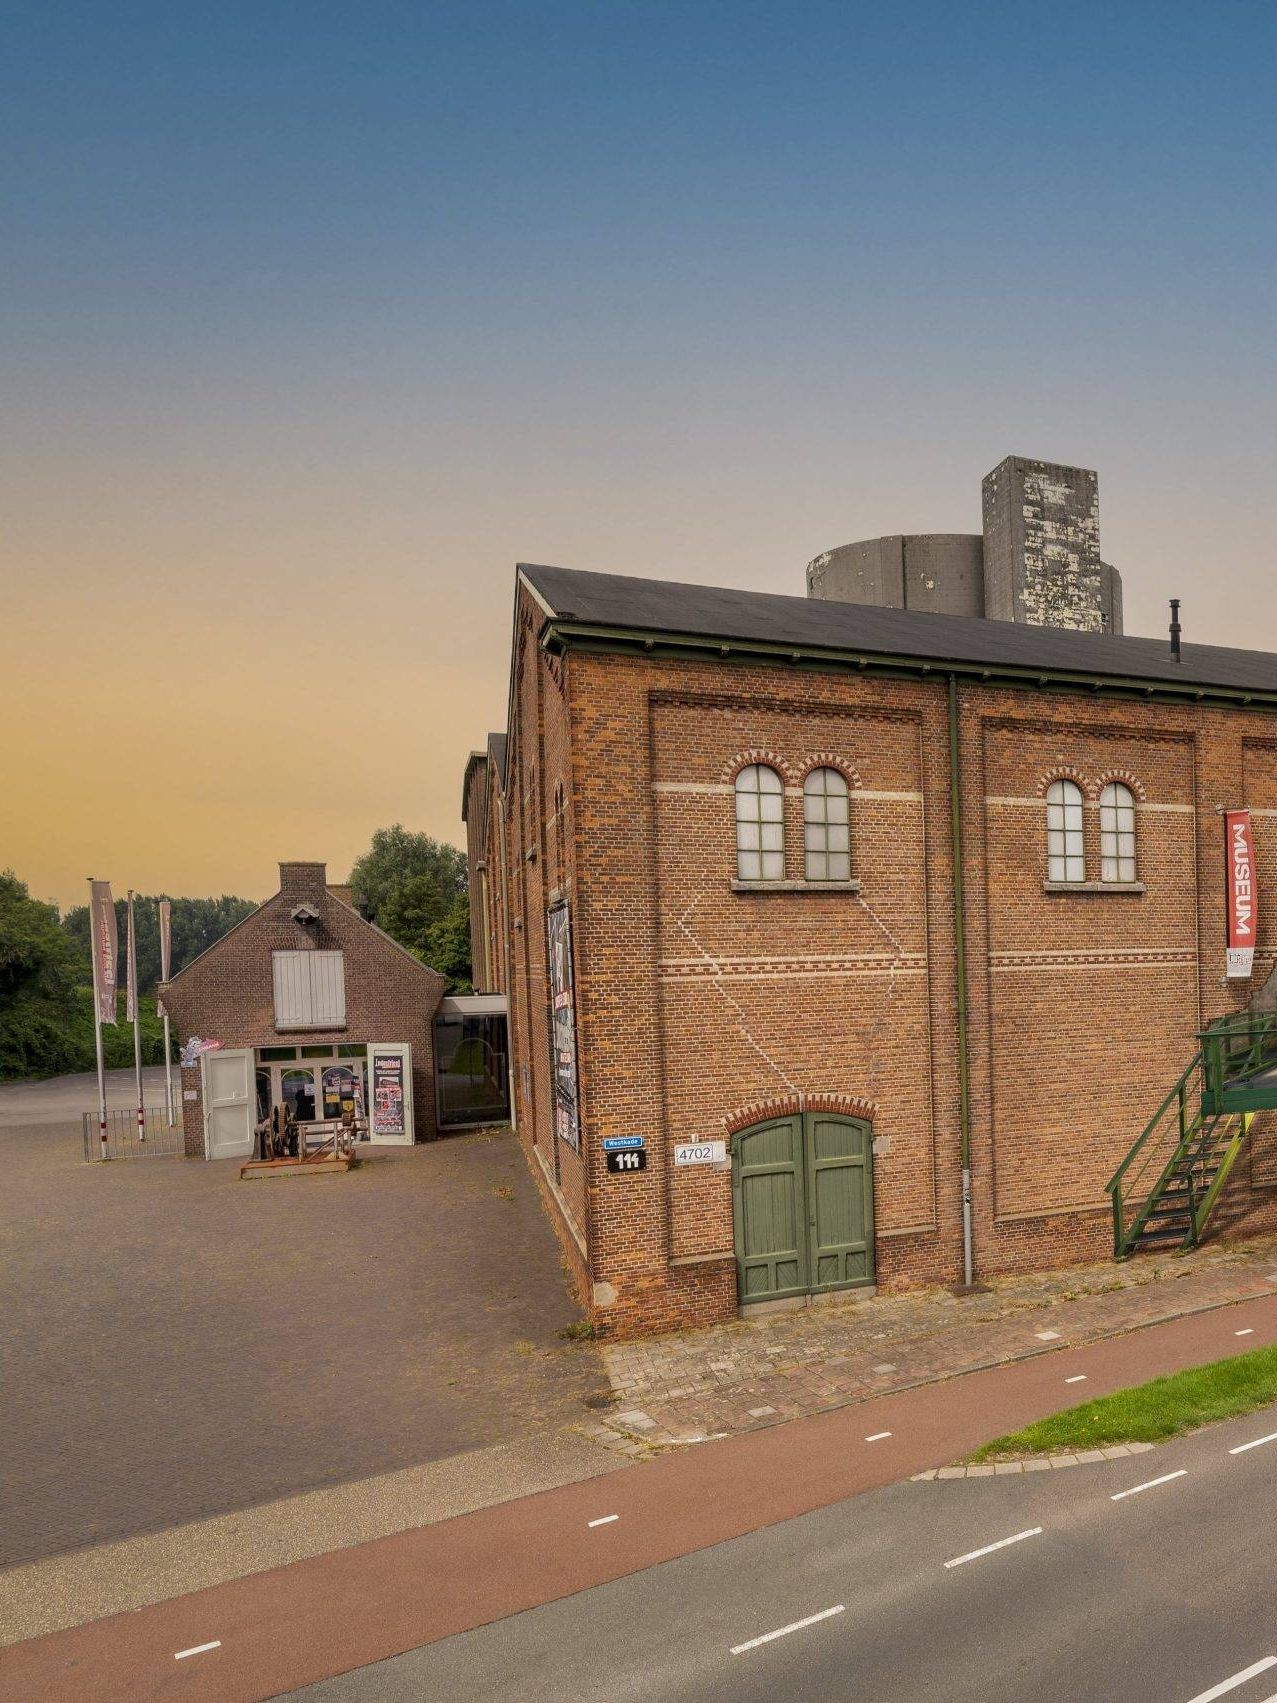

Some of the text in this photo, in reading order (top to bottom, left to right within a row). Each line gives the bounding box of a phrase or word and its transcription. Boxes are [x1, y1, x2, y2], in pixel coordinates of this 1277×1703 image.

[1233, 823, 1251, 935] MUSEUM
[609, 1139, 638, 1147] Westkade
[680, 1147, 712, 1160] 4702
